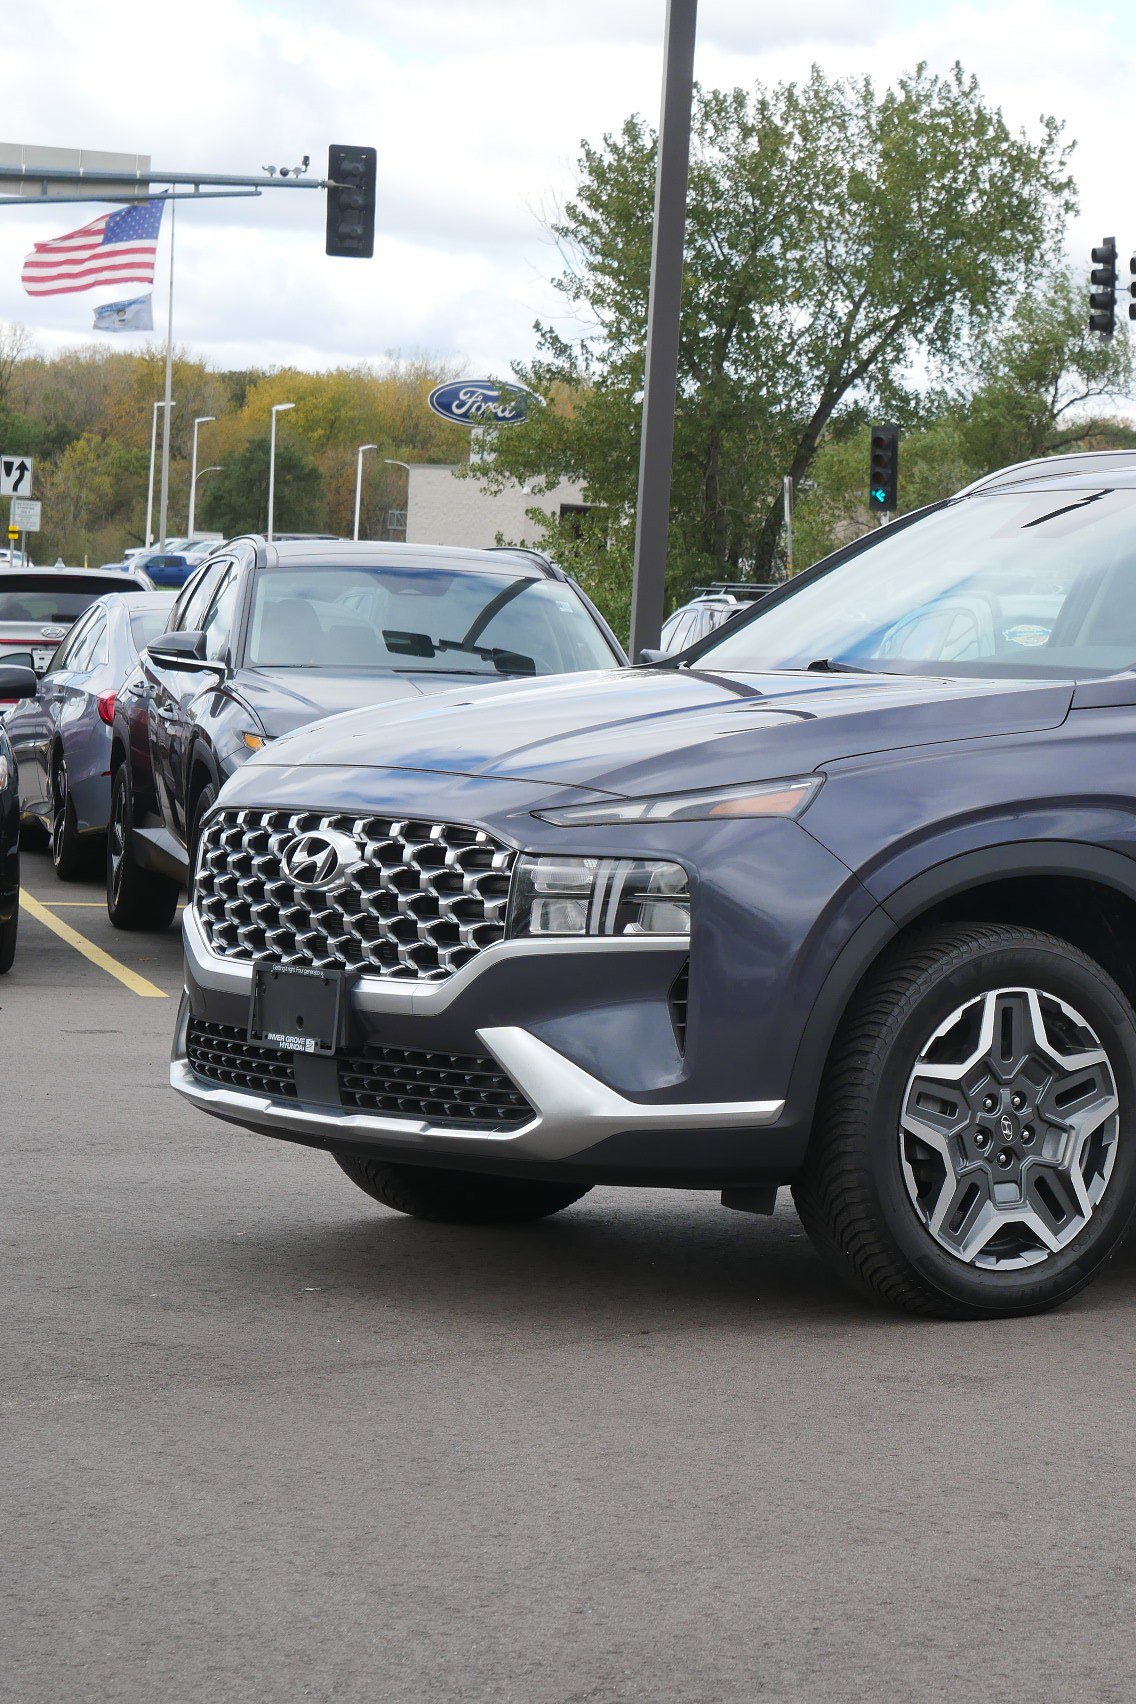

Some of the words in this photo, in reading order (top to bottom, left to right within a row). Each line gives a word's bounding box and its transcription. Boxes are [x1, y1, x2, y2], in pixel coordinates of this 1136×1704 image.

[452, 387, 517, 418] Ford
[267, 1033, 285, 1041] INVER
[286, 1036, 305, 1044] GROVE
[280, 1042, 304, 1051] HYUNDAI
